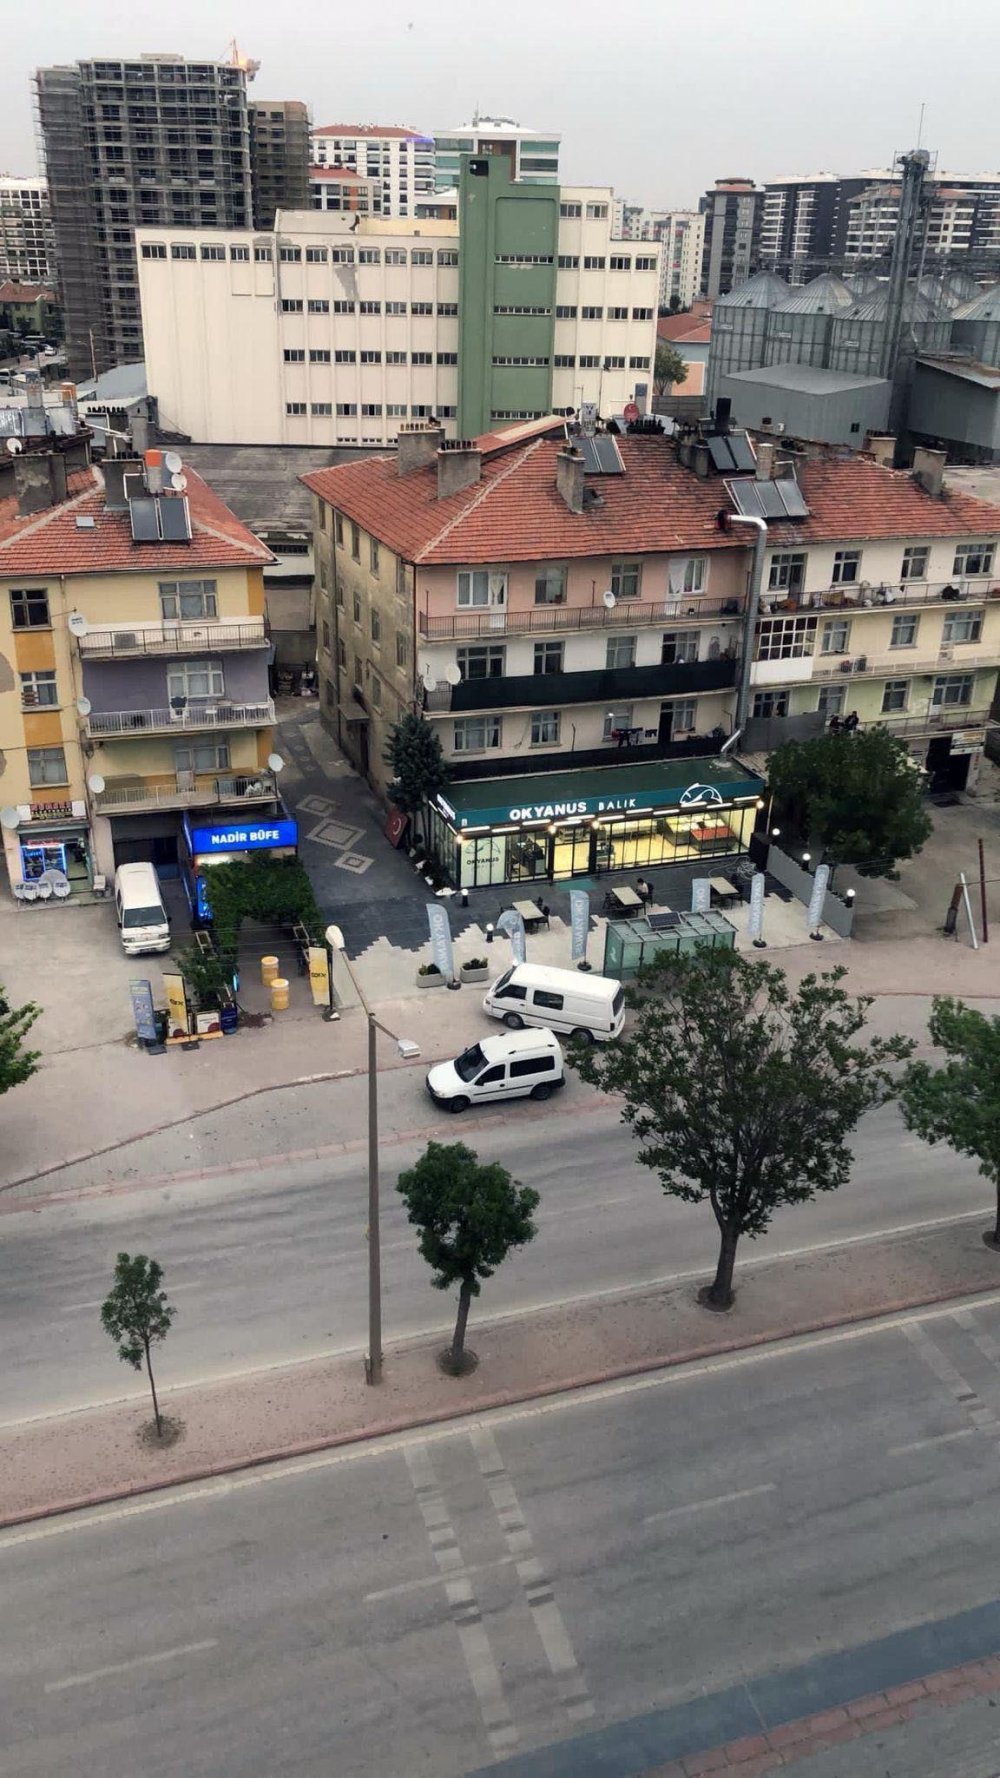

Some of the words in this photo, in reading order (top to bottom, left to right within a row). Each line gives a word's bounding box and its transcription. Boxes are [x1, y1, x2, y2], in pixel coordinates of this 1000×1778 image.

[509, 801, 587, 820] OKYANUS
[598, 798, 636, 811] BALIK
[211, 831, 247, 844] NADİR
